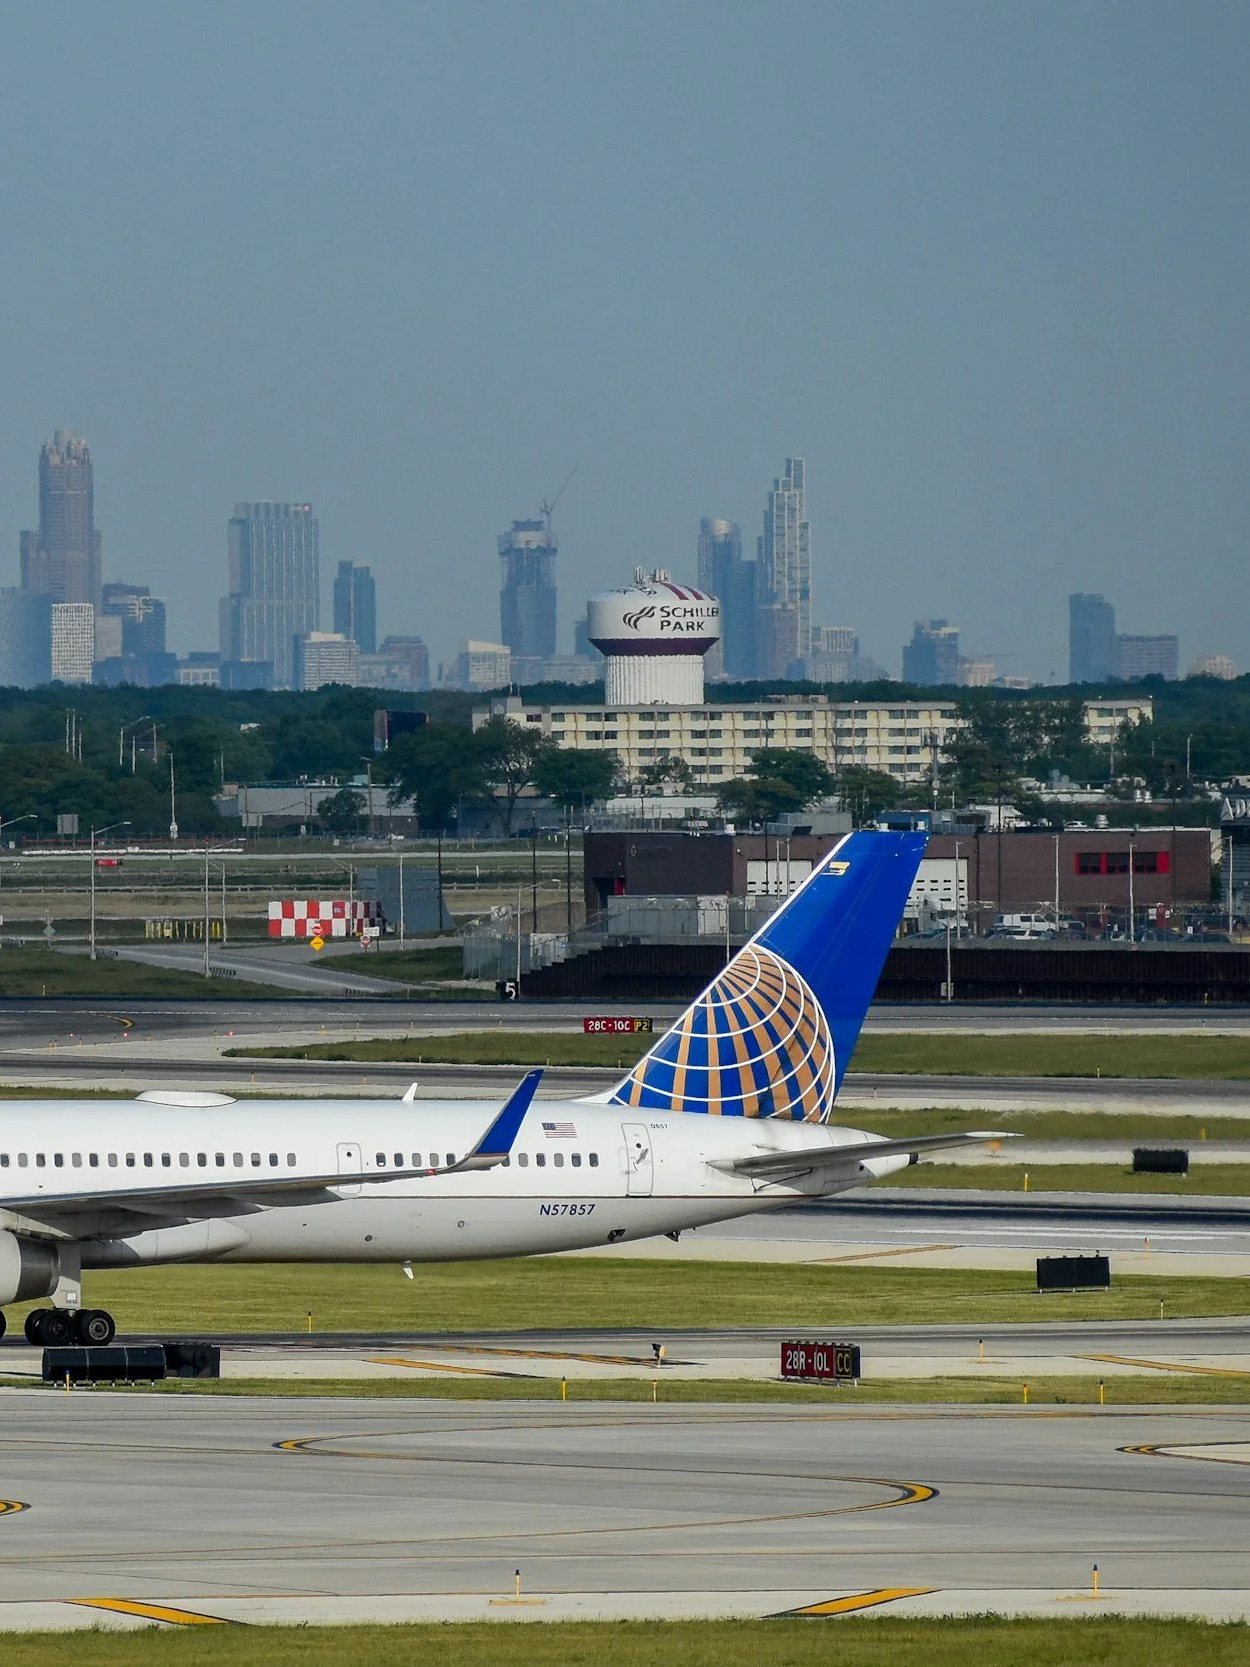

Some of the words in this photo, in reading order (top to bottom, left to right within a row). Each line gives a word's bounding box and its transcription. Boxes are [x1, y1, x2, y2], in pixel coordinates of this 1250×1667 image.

[659, 619, 706, 632] PARK
[1220, 797, 1250, 820] AD
[505, 982, 516, 1000] 5
[635, 1021, 648, 1031] P2
[539, 1203, 596, 1216] N57857
[785, 1349, 830, 1372] 28R-10L
[836, 1352, 850, 1373] CC
